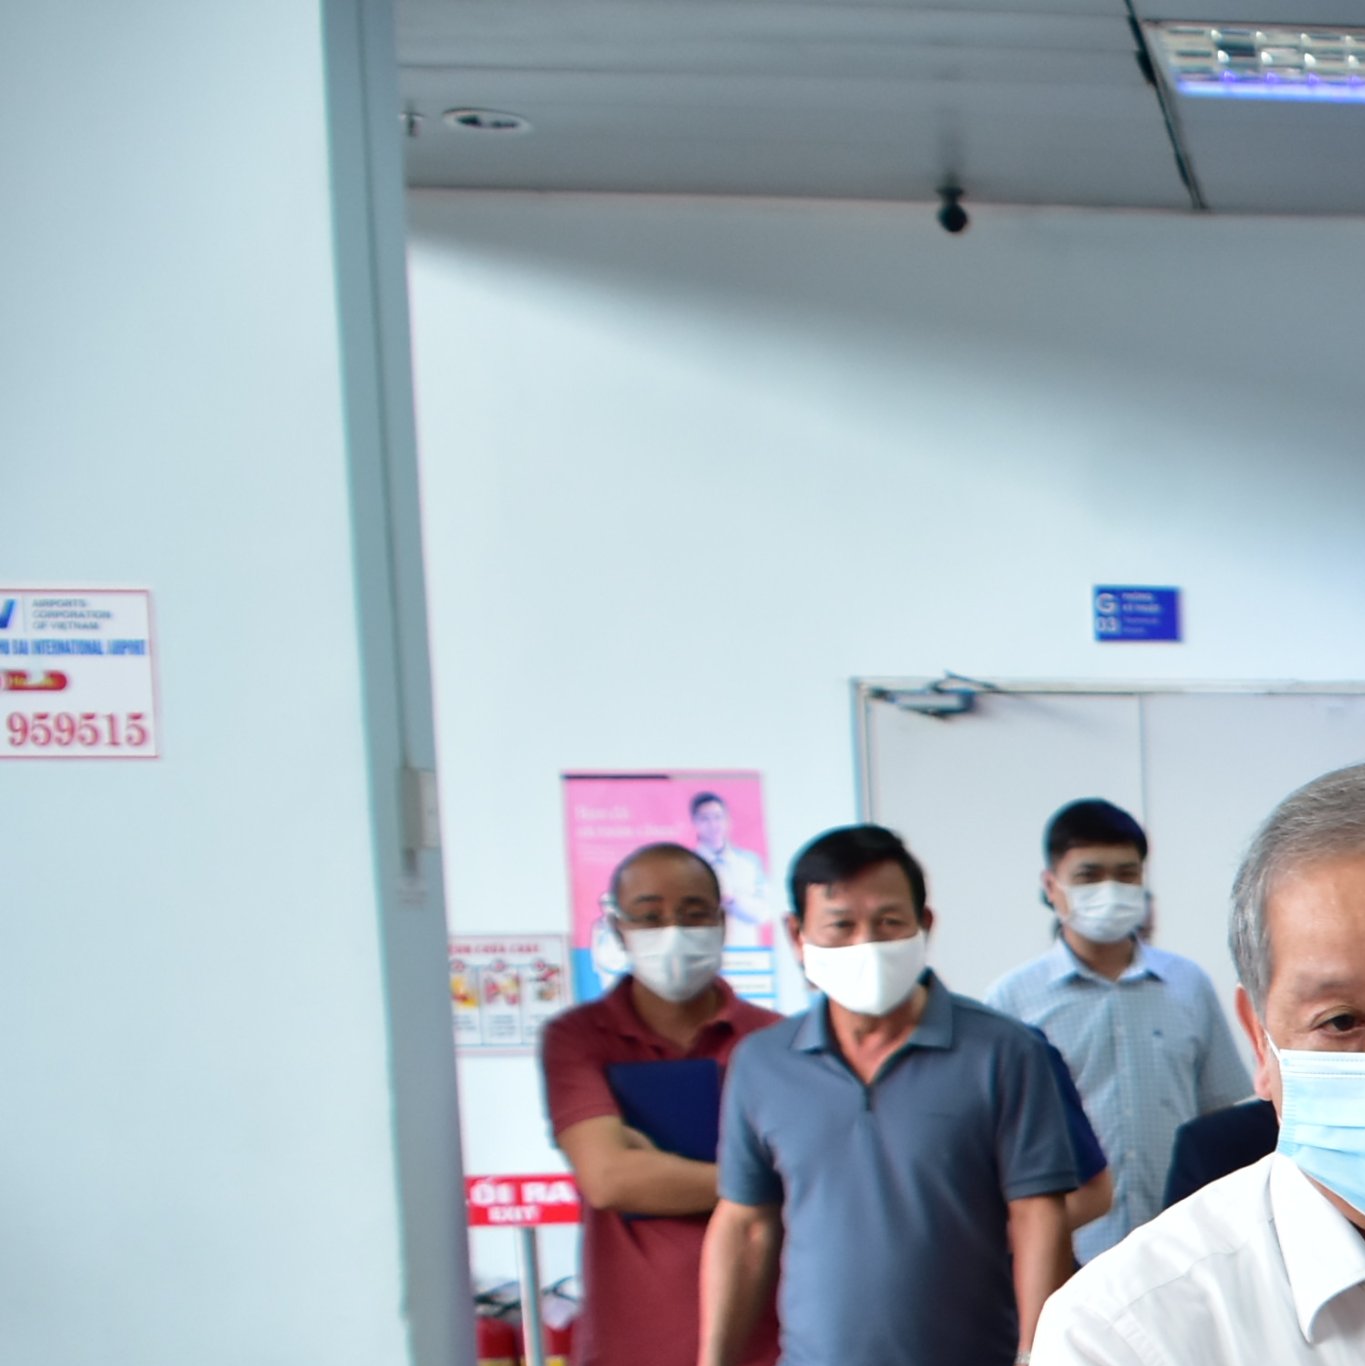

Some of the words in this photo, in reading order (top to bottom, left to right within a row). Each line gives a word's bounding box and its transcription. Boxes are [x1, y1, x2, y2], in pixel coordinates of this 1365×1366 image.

[1097, 593, 1117, 613] G
[33, 610, 111, 619] CORPORATION
[33, 621, 48, 630] OF
[51, 621, 99, 630] VIETNAM
[32, 639, 103, 655] INTERNATIONAL
[107, 640, 145, 655] AIRPORT
[7, 712, 149, 747] 959515
[466, 1176, 514, 1205] ỐI
[521, 1182, 577, 1204] RA
[487, 1205, 540, 1222] EXIT
